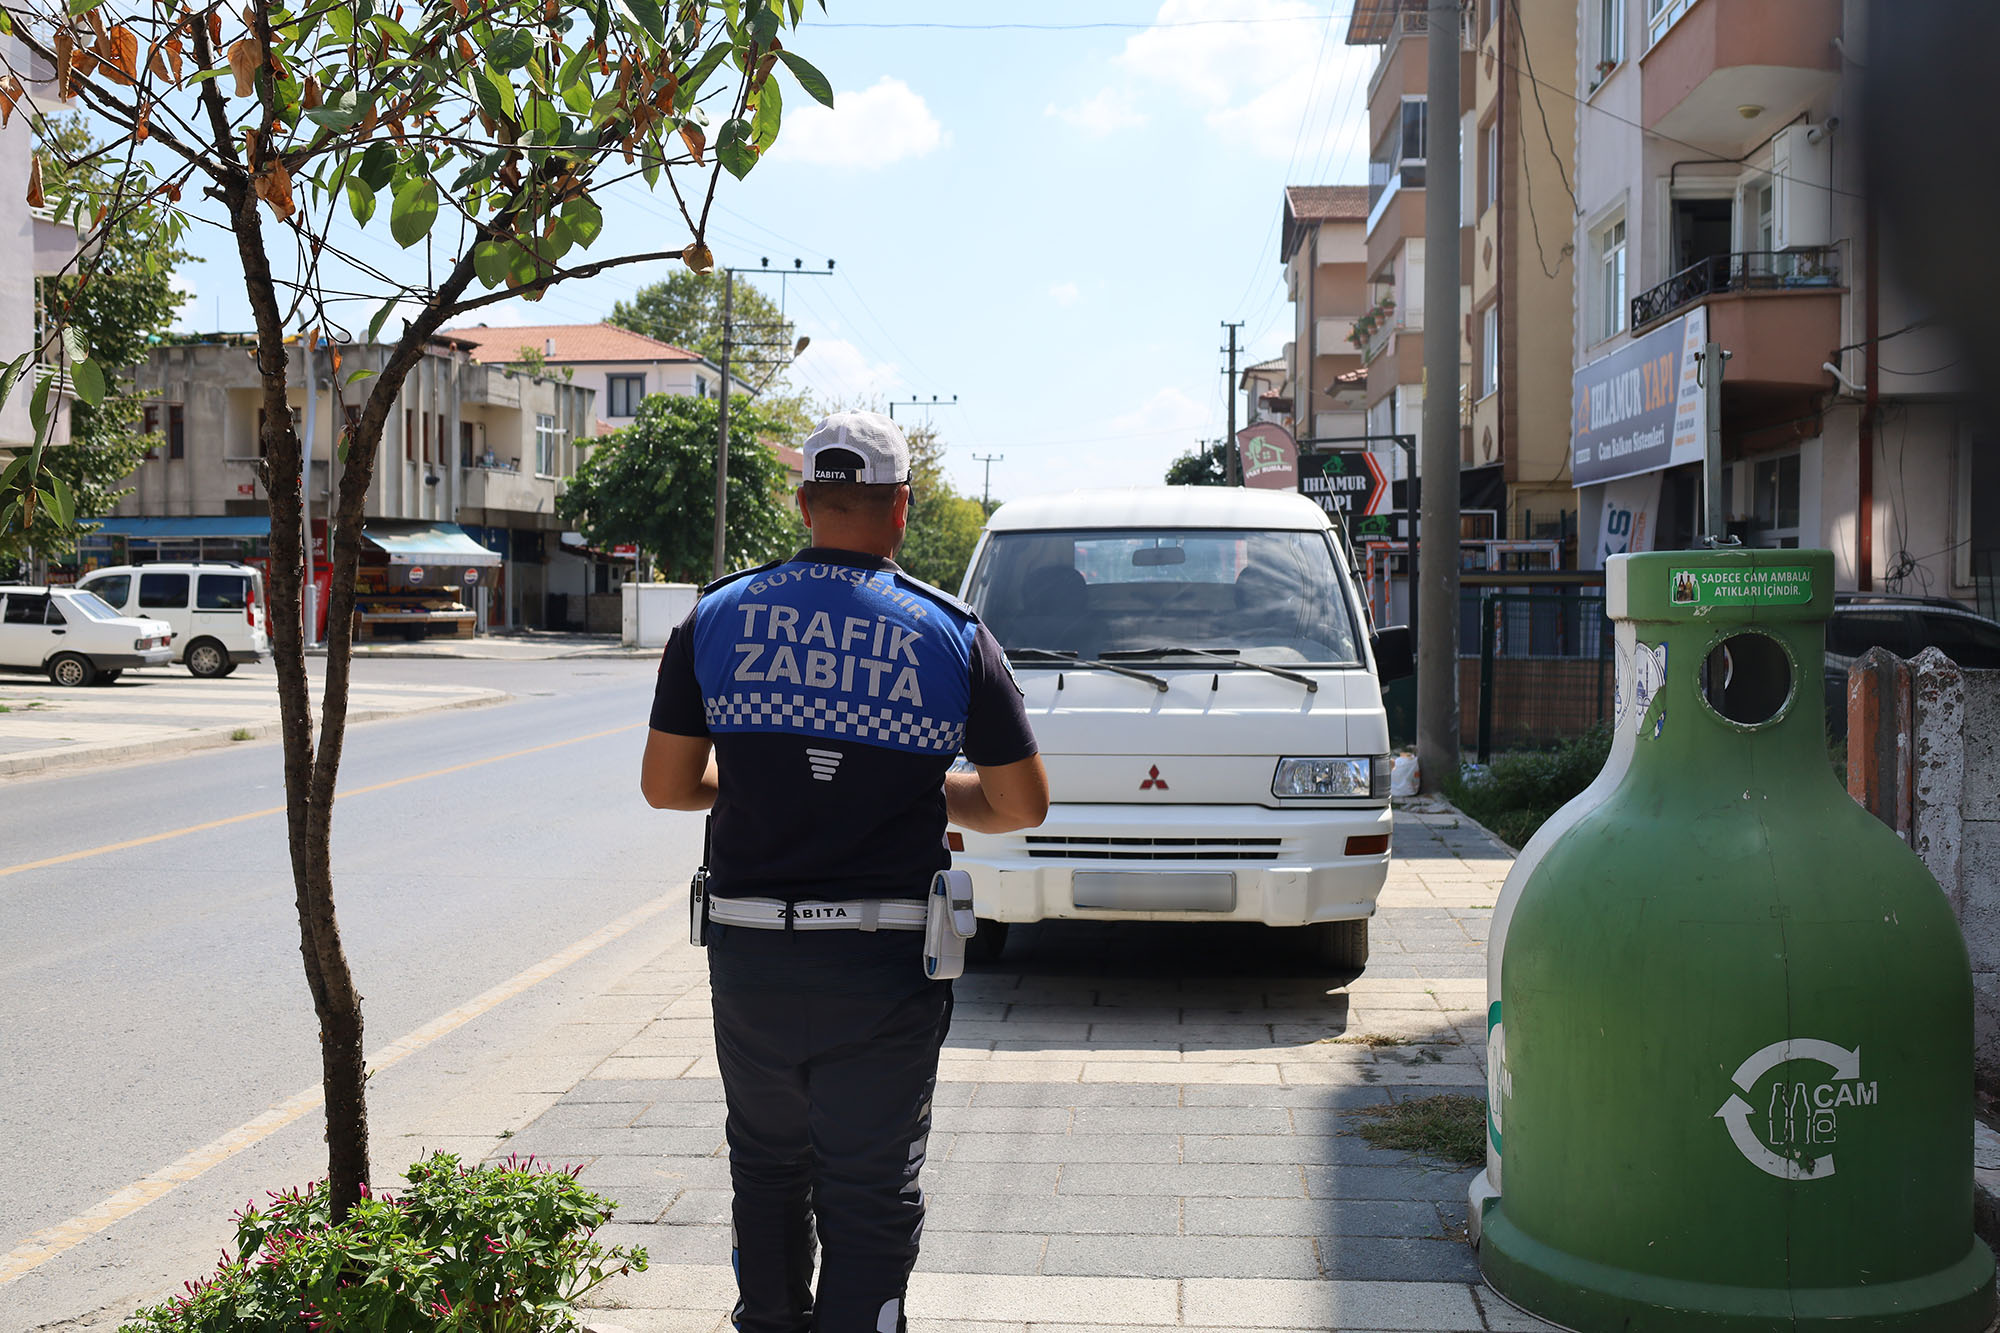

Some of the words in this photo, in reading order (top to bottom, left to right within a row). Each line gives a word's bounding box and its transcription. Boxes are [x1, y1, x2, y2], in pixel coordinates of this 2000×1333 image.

[1643, 351, 1675, 412] YAPI
[815, 470, 846, 480] ZABITA
[1303, 475, 1366, 492] IHLAMUR
[1313, 494, 1353, 512] YAPI
[1701, 573, 1741, 584] SADECE
[1743, 572, 1768, 583] CAM
[747, 563, 928, 621] BÜYÜKŞEHİR
[1714, 585, 1761, 597] ATIKLARI
[737, 603, 924, 667] TRAFİK
[733, 643, 924, 707] ZABITA
[777, 907, 847, 919] ZABITA
[1813, 1081, 1878, 1108] CAM
